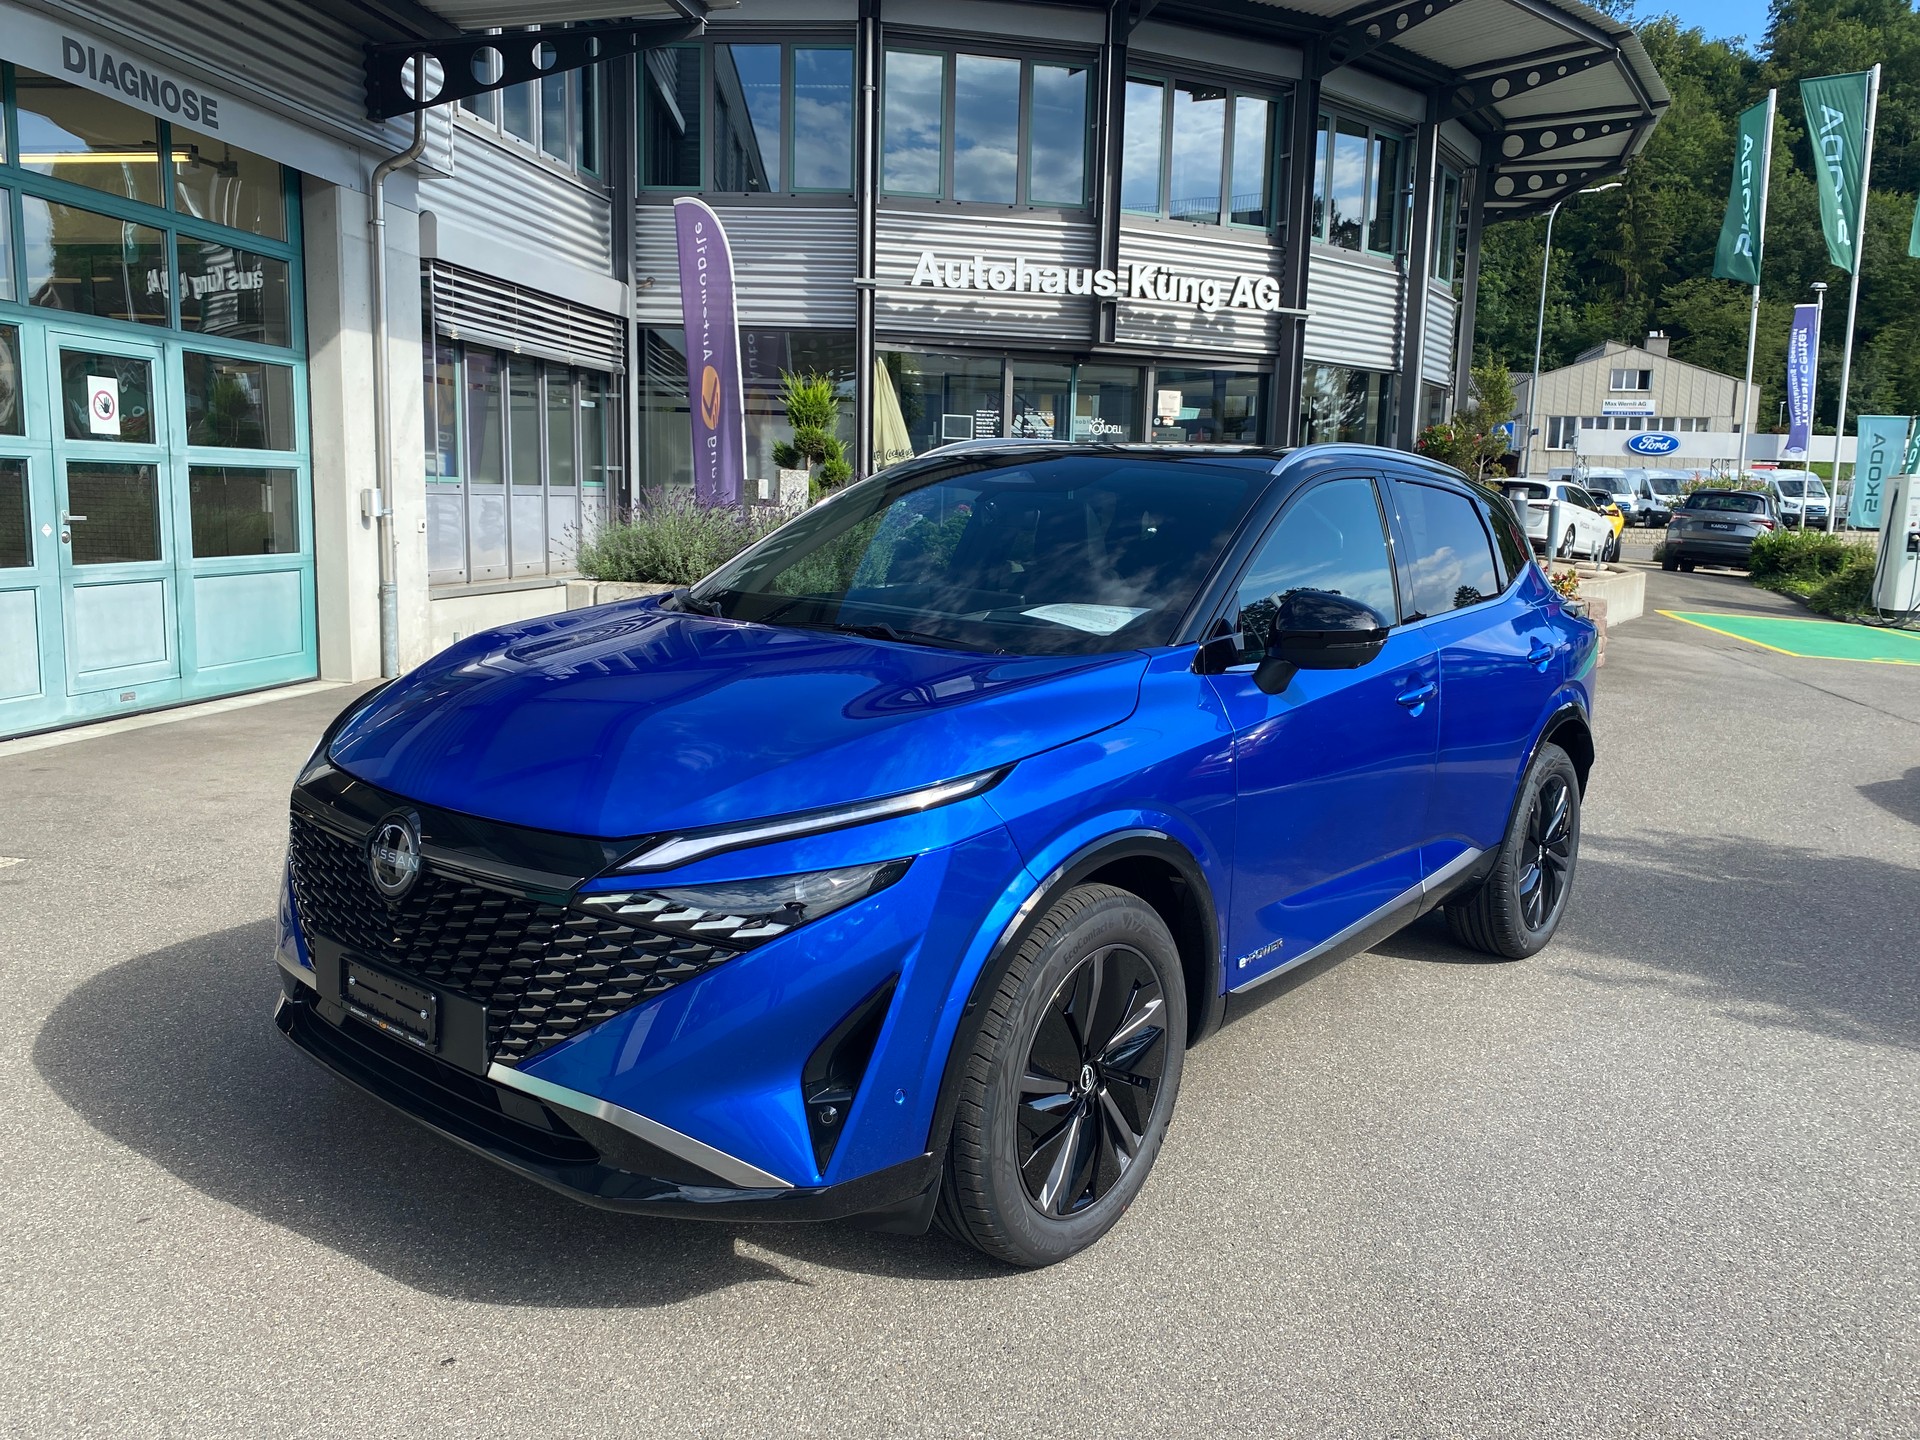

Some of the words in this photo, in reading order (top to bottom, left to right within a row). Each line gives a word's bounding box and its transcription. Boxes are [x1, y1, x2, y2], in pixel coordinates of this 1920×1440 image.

[62, 35, 219, 130] DIAGNOSE
[911, 251, 1117, 297] Autohaus
[1128, 263, 1222, 313] Küng
[1230, 275, 1281, 311] AG
[1638, 435, 1671, 451] Ford
[371, 843, 419, 870] NISSAN
[1062, 922, 1110, 965] EcoContact
